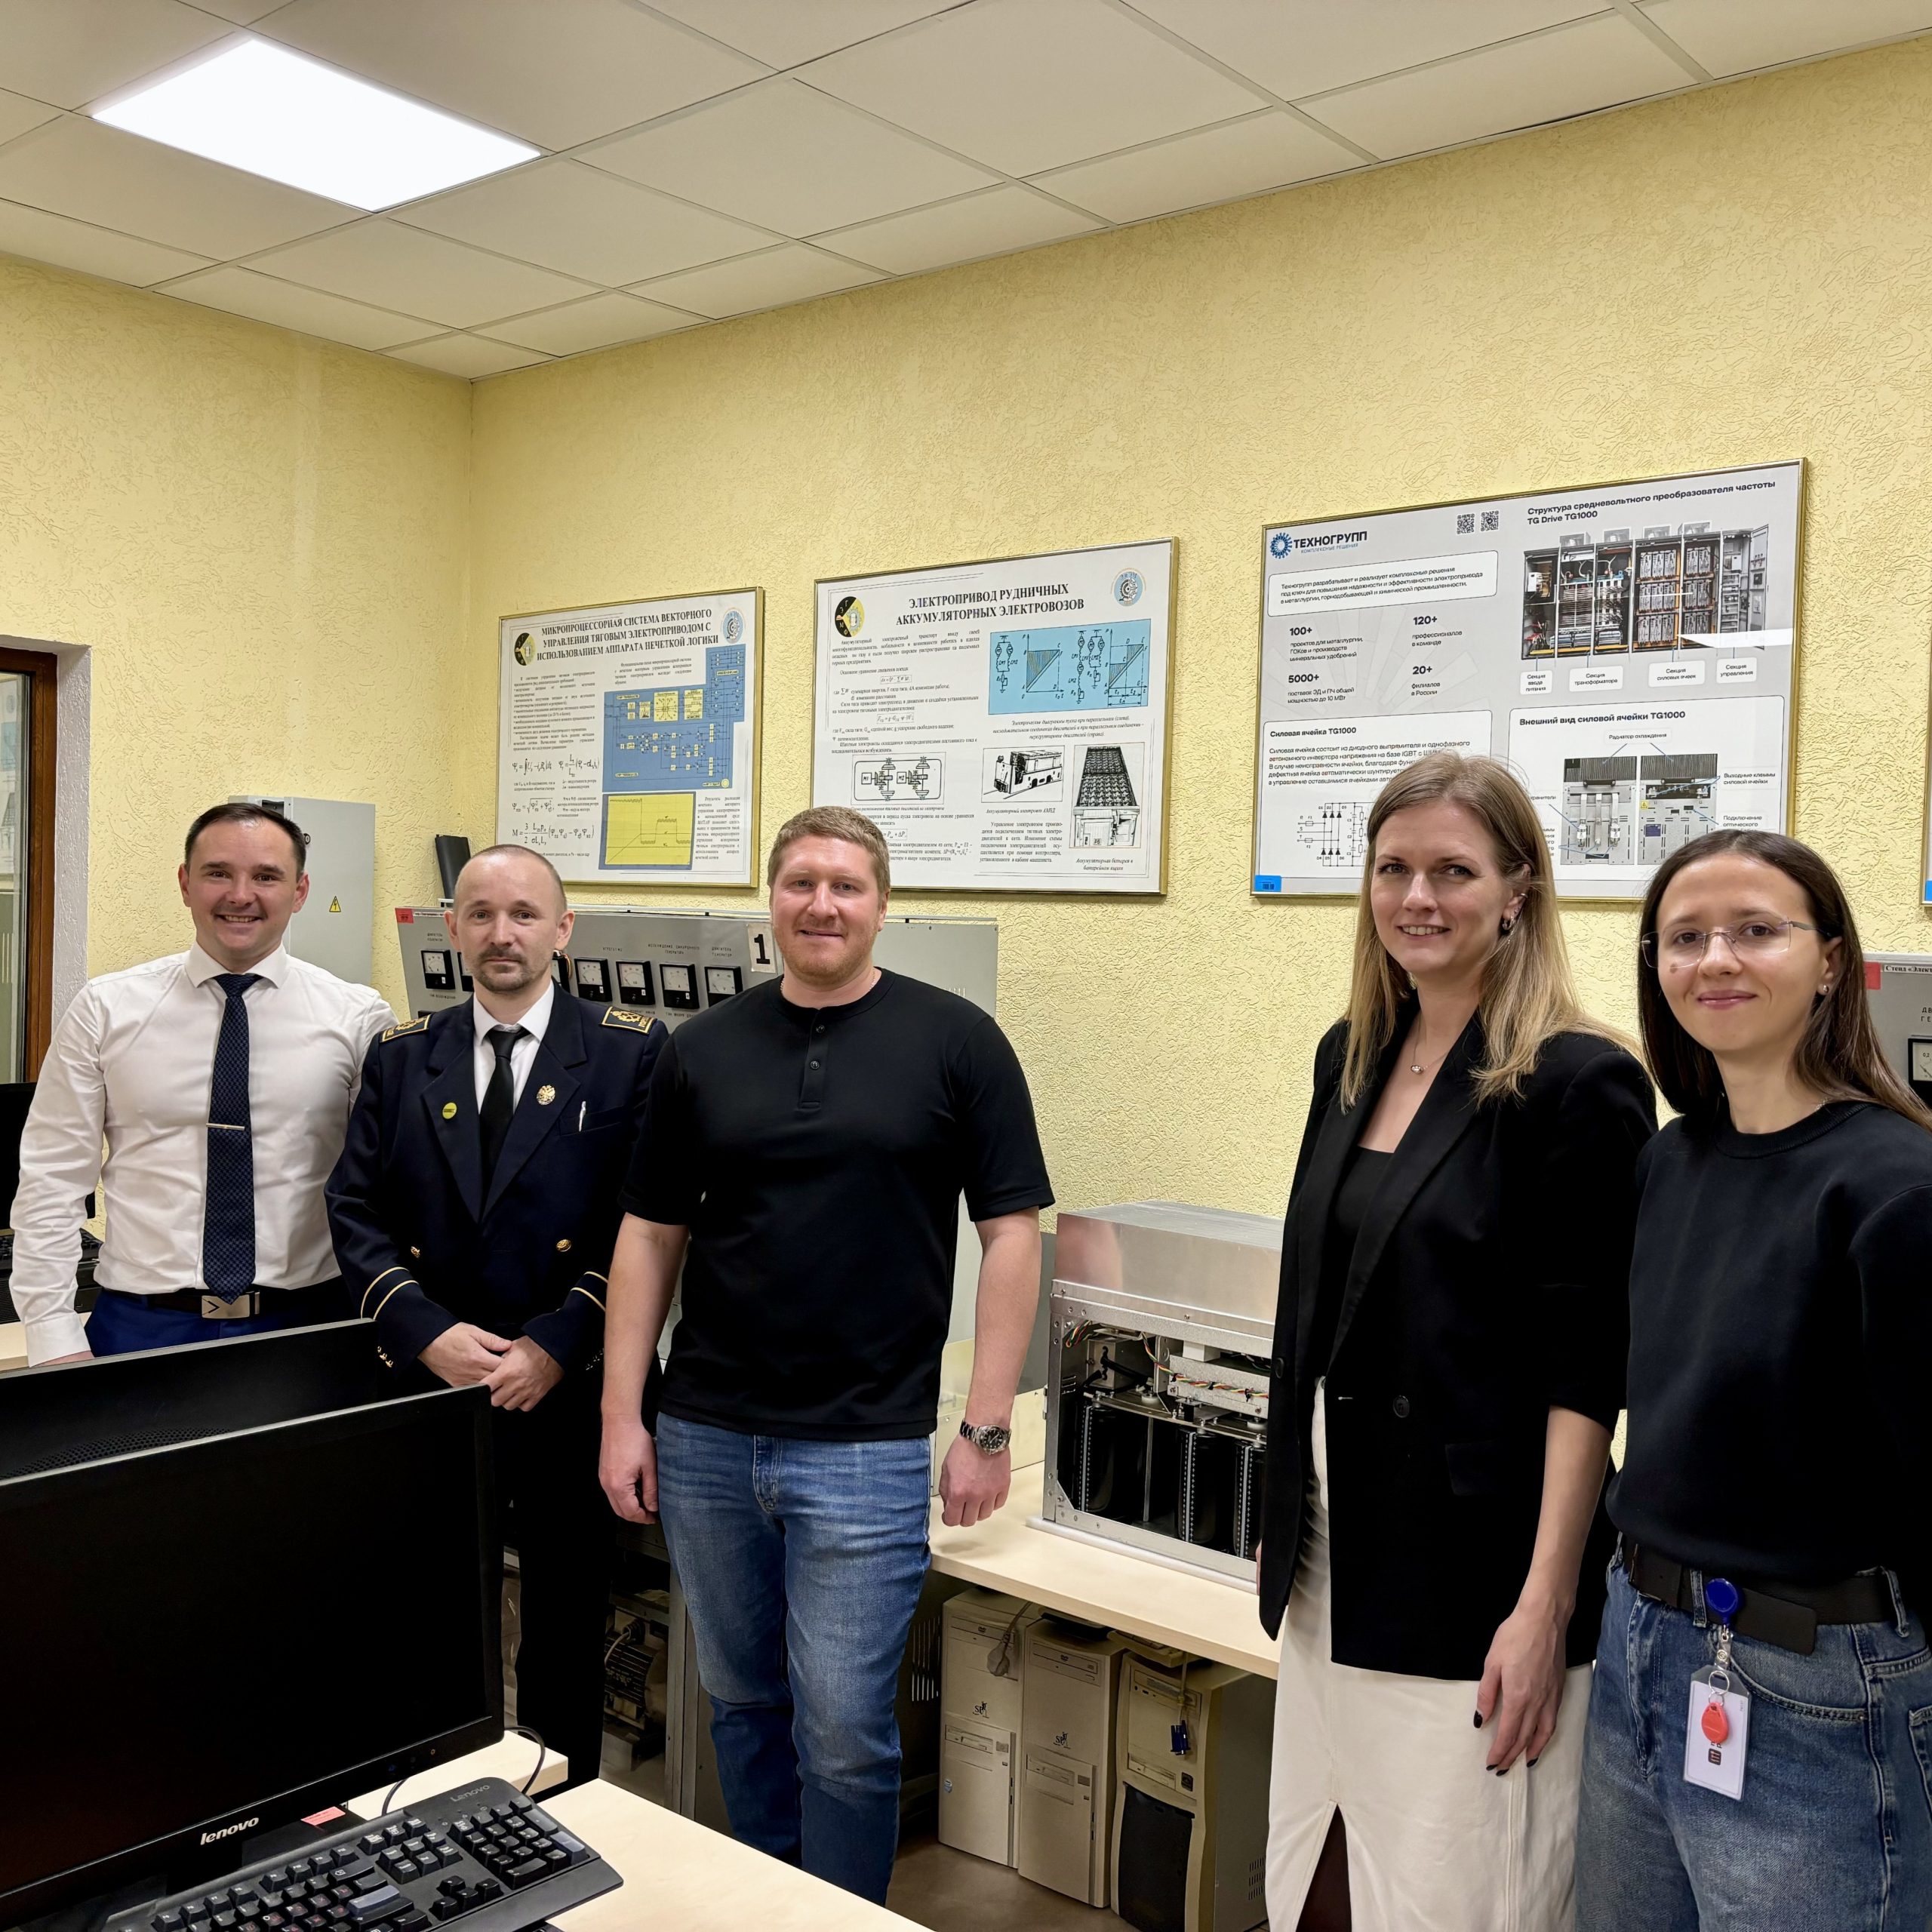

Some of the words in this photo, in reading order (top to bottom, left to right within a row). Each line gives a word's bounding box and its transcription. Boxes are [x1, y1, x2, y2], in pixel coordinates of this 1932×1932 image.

[1527, 505, 1572, 515] Структура
[1574, 496, 1651, 510] средневольтного
[1653, 486, 1734, 501] преобразователя
[1736, 481, 1776, 491] частоты
[1541, 515, 1563, 523] Drive
[1564, 510, 1598, 520] TG1000
[1294, 531, 1367, 549] ТЕХНОГРУПП
[909, 590, 997, 608] ЭЛЕКТРОПРИВОД
[1000, 583, 1069, 600] РУДНИЧНЫХ
[541, 618, 623, 635] МИКРОПРОЦЕССОРНАЯ
[623, 614, 660, 626] СИСТЕМА
[661, 608, 712, 622] ВЕКТОРНОГО
[896, 607, 997, 625] АККУМУЛЯТОРНЫХ
[999, 598, 1084, 616] ЭЛЕКТРОВОЗОВ
[1413, 616, 1438, 625] 120+
[543, 635, 589, 648] УПРАВЛЕНИЯ
[591, 631, 626, 642] ТЯГОВЫМ
[628, 623, 703, 638] ЭЛЕКТРОПРИВОДОМ
[706, 622, 711, 631] С
[1290, 626, 1312, 635] 100+
[537, 646, 603, 660] ИСПОЛЬЗОВАНИЕМ
[605, 642, 643, 654] АППАРАТА
[645, 638, 685, 650] НЕЧЕТКОЙ
[687, 635, 718, 645] ЛОГИКИ
[1288, 674, 1319, 683] 5000+
[1412, 666, 1432, 675] 20+
[1519, 716, 1558, 725] Внешний
[1577, 714, 1615, 722] силовой
[754, 934, 771, 964] 1
[450, 1784, 490, 1803] Lenovo
[200, 1817, 260, 1846] lenovo
